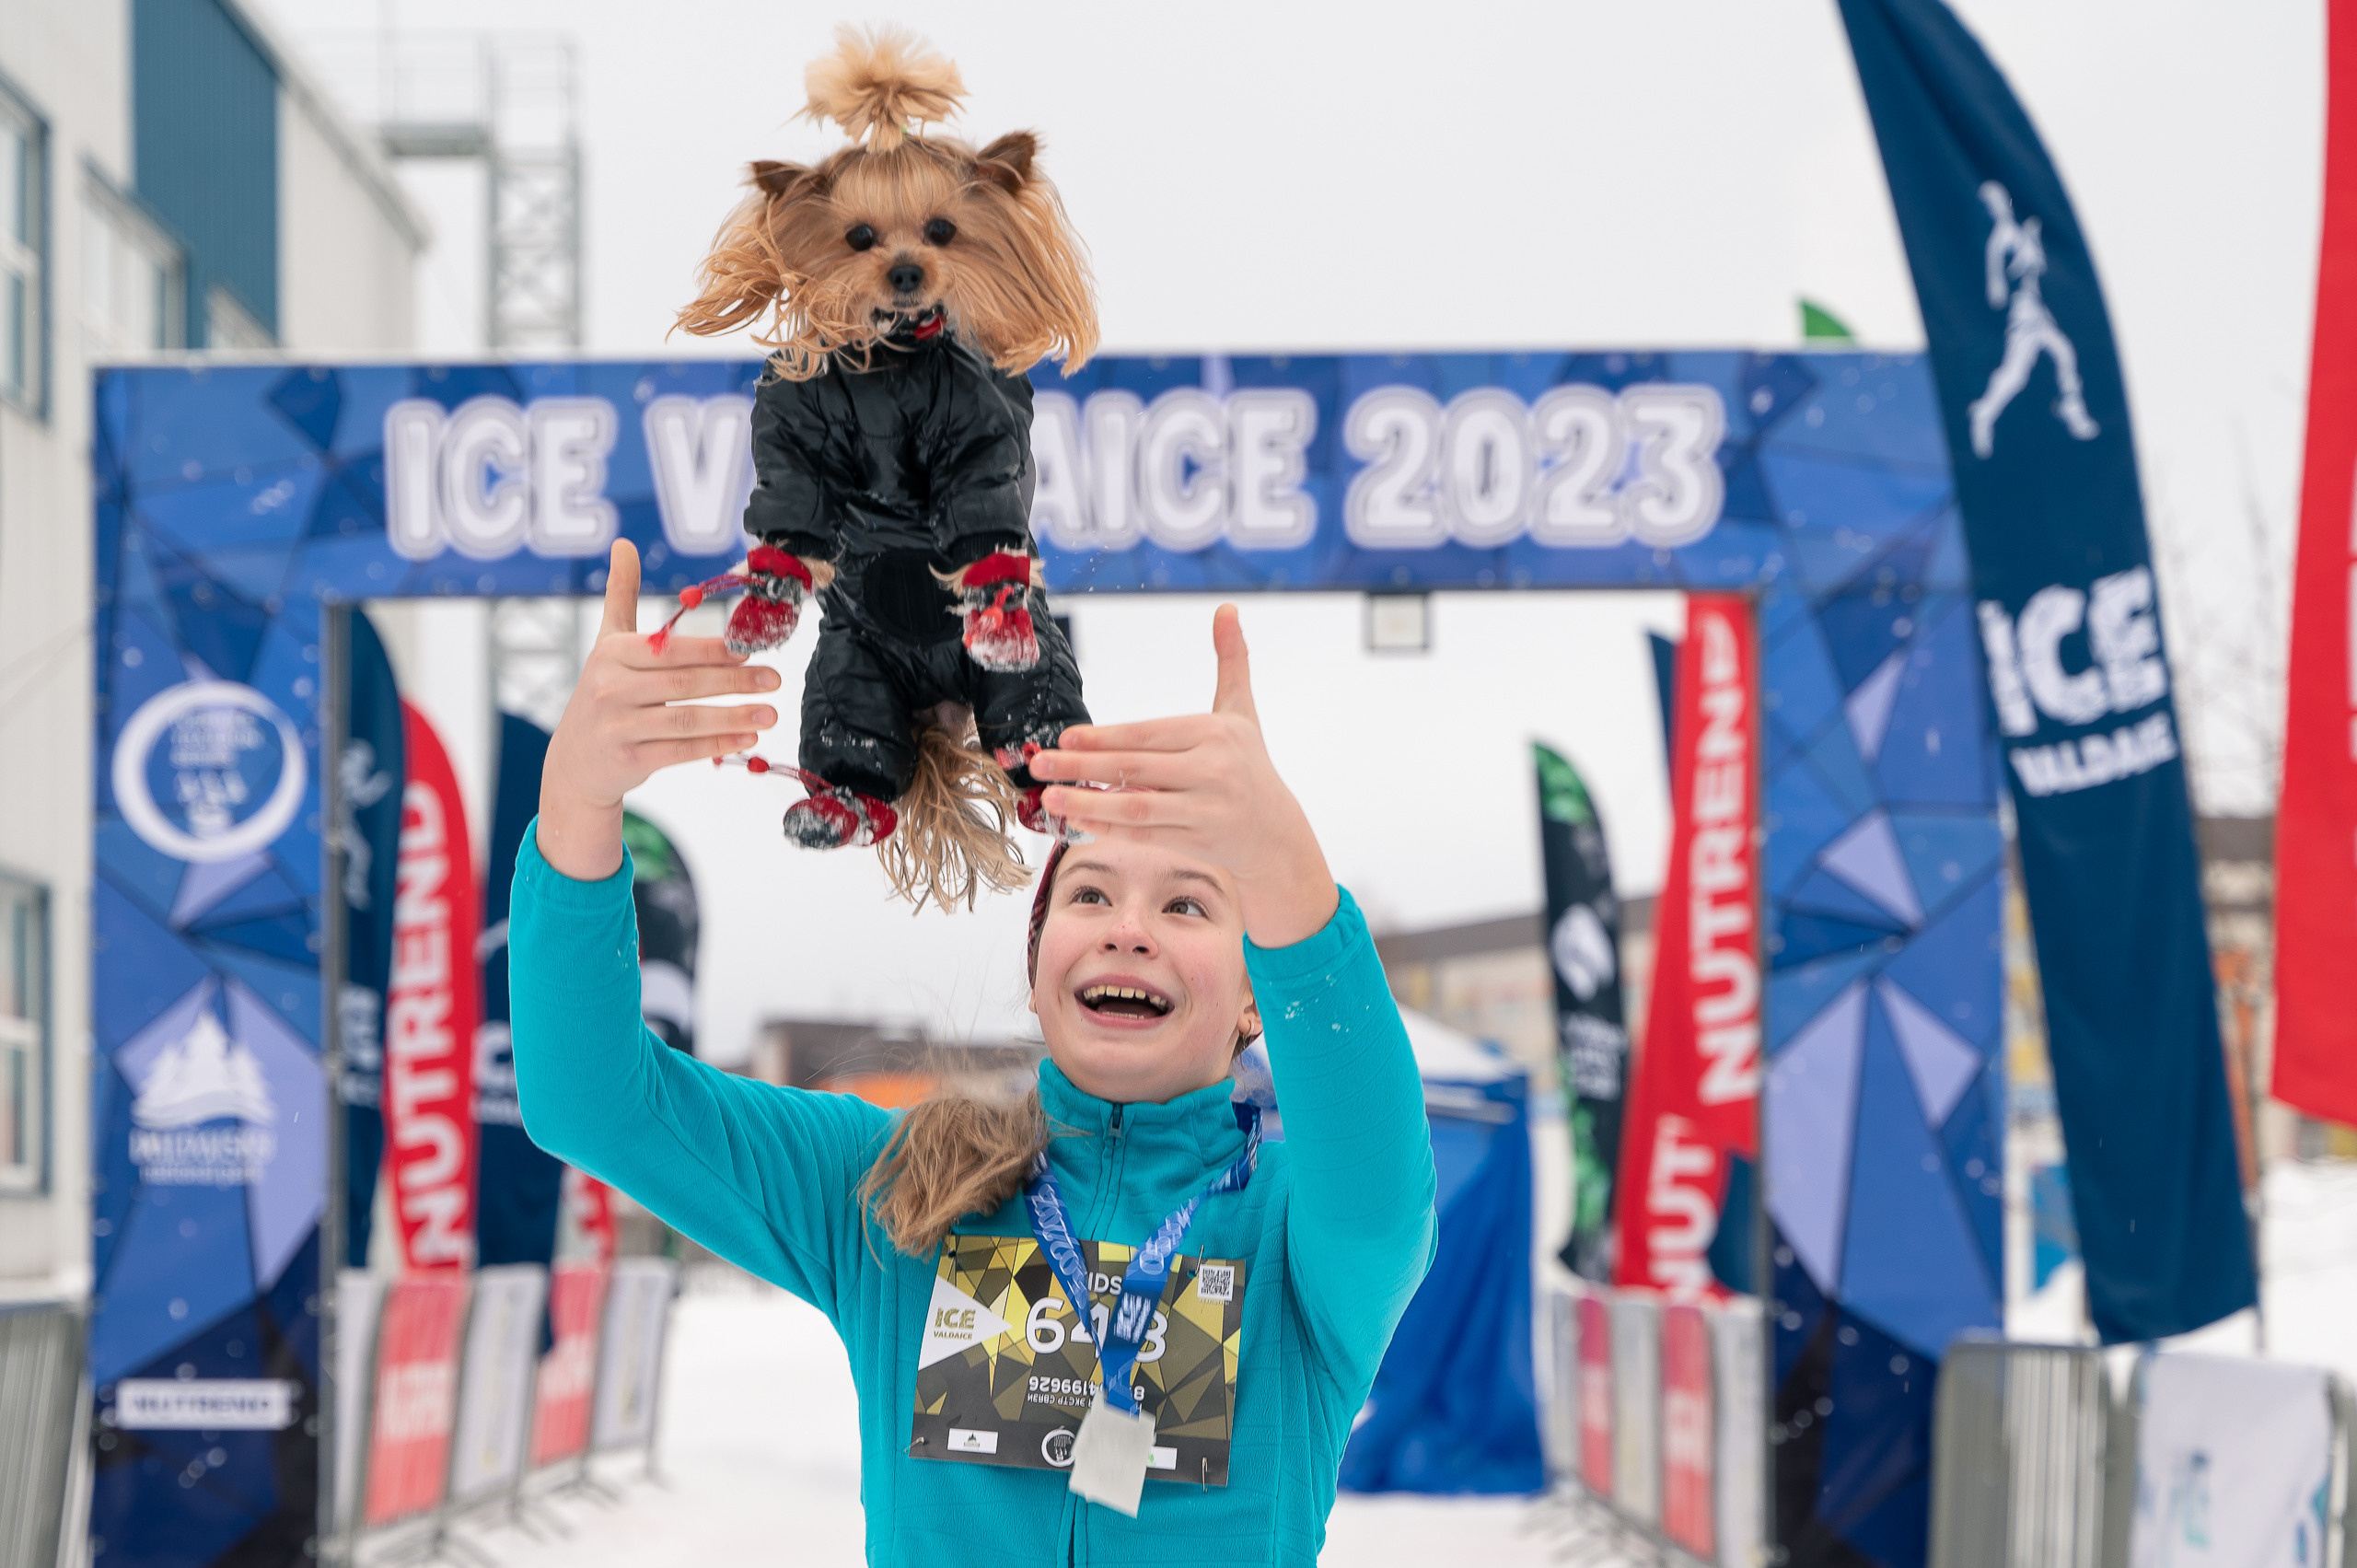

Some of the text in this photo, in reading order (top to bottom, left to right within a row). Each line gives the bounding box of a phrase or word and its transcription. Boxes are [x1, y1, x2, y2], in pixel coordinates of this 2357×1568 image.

[387, 385, 1726, 559] ICE VAICE 2023
[1977, 563, 2167, 737] ICE
[388, 781, 477, 1265] NUTREND
[1087, 1271, 1123, 1295] IDS
[933, 1330, 974, 1342] VALDAICE
[934, 1307, 976, 1330] ICE
[1025, 1296, 1168, 1364] 643
